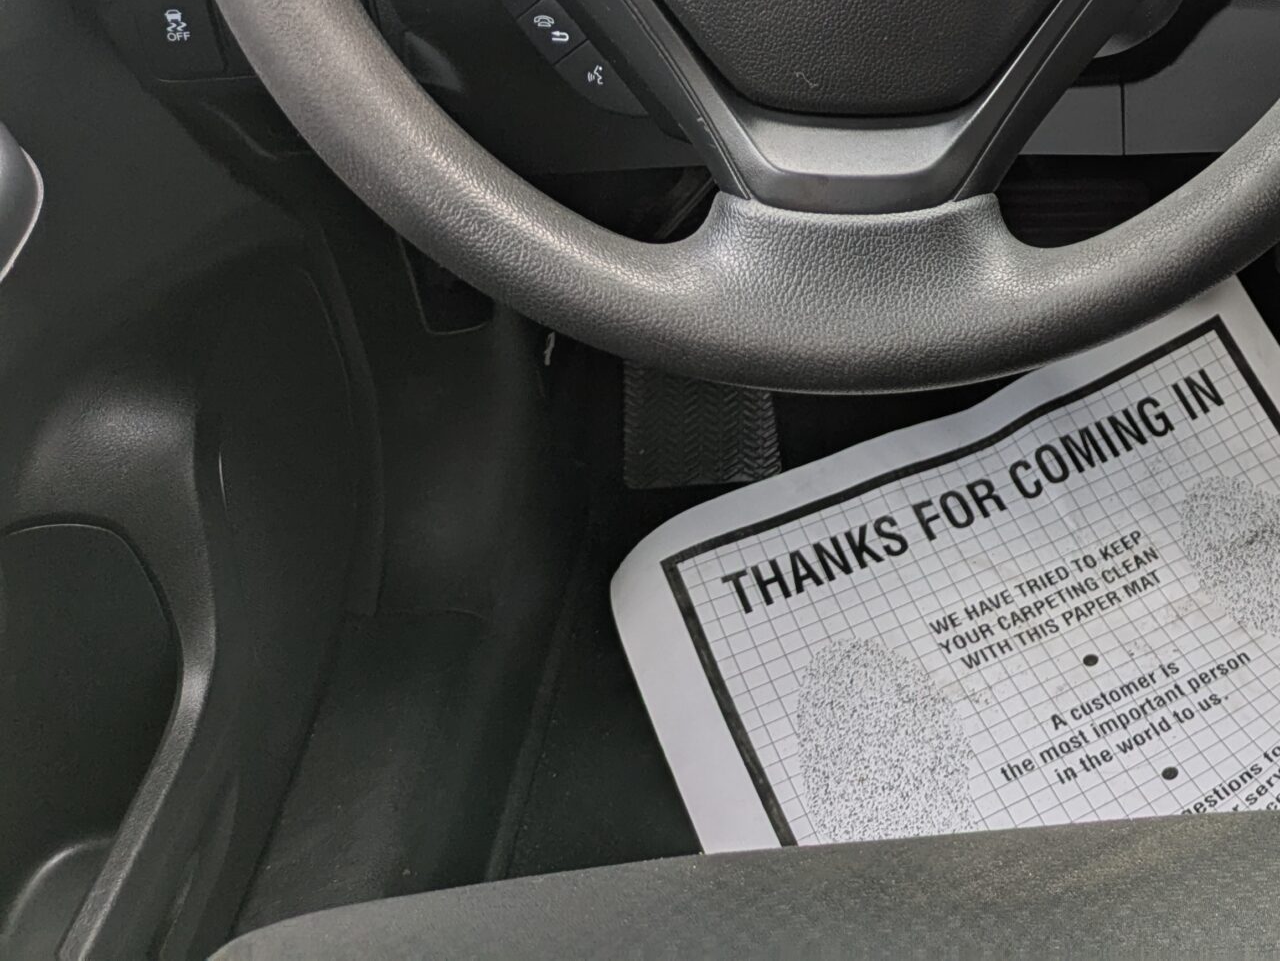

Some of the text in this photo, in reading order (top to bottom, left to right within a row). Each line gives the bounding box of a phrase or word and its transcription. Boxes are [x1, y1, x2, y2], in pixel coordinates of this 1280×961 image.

[167, 32, 190, 41] OFF
[721, 368, 1225, 614] THANKS FOR COMING IN
[929, 530, 1142, 636] WE HAVE TRIED TO KEEP
[938, 546, 1160, 655] YOUR CARPETING CLEAN
[960, 570, 1162, 670] WITH THIS PAPER MAT
[1000, 650, 1252, 783] the most important person
[1050, 661, 1180, 731] A customer is
[1055, 692, 1230, 785] in the world to us.
